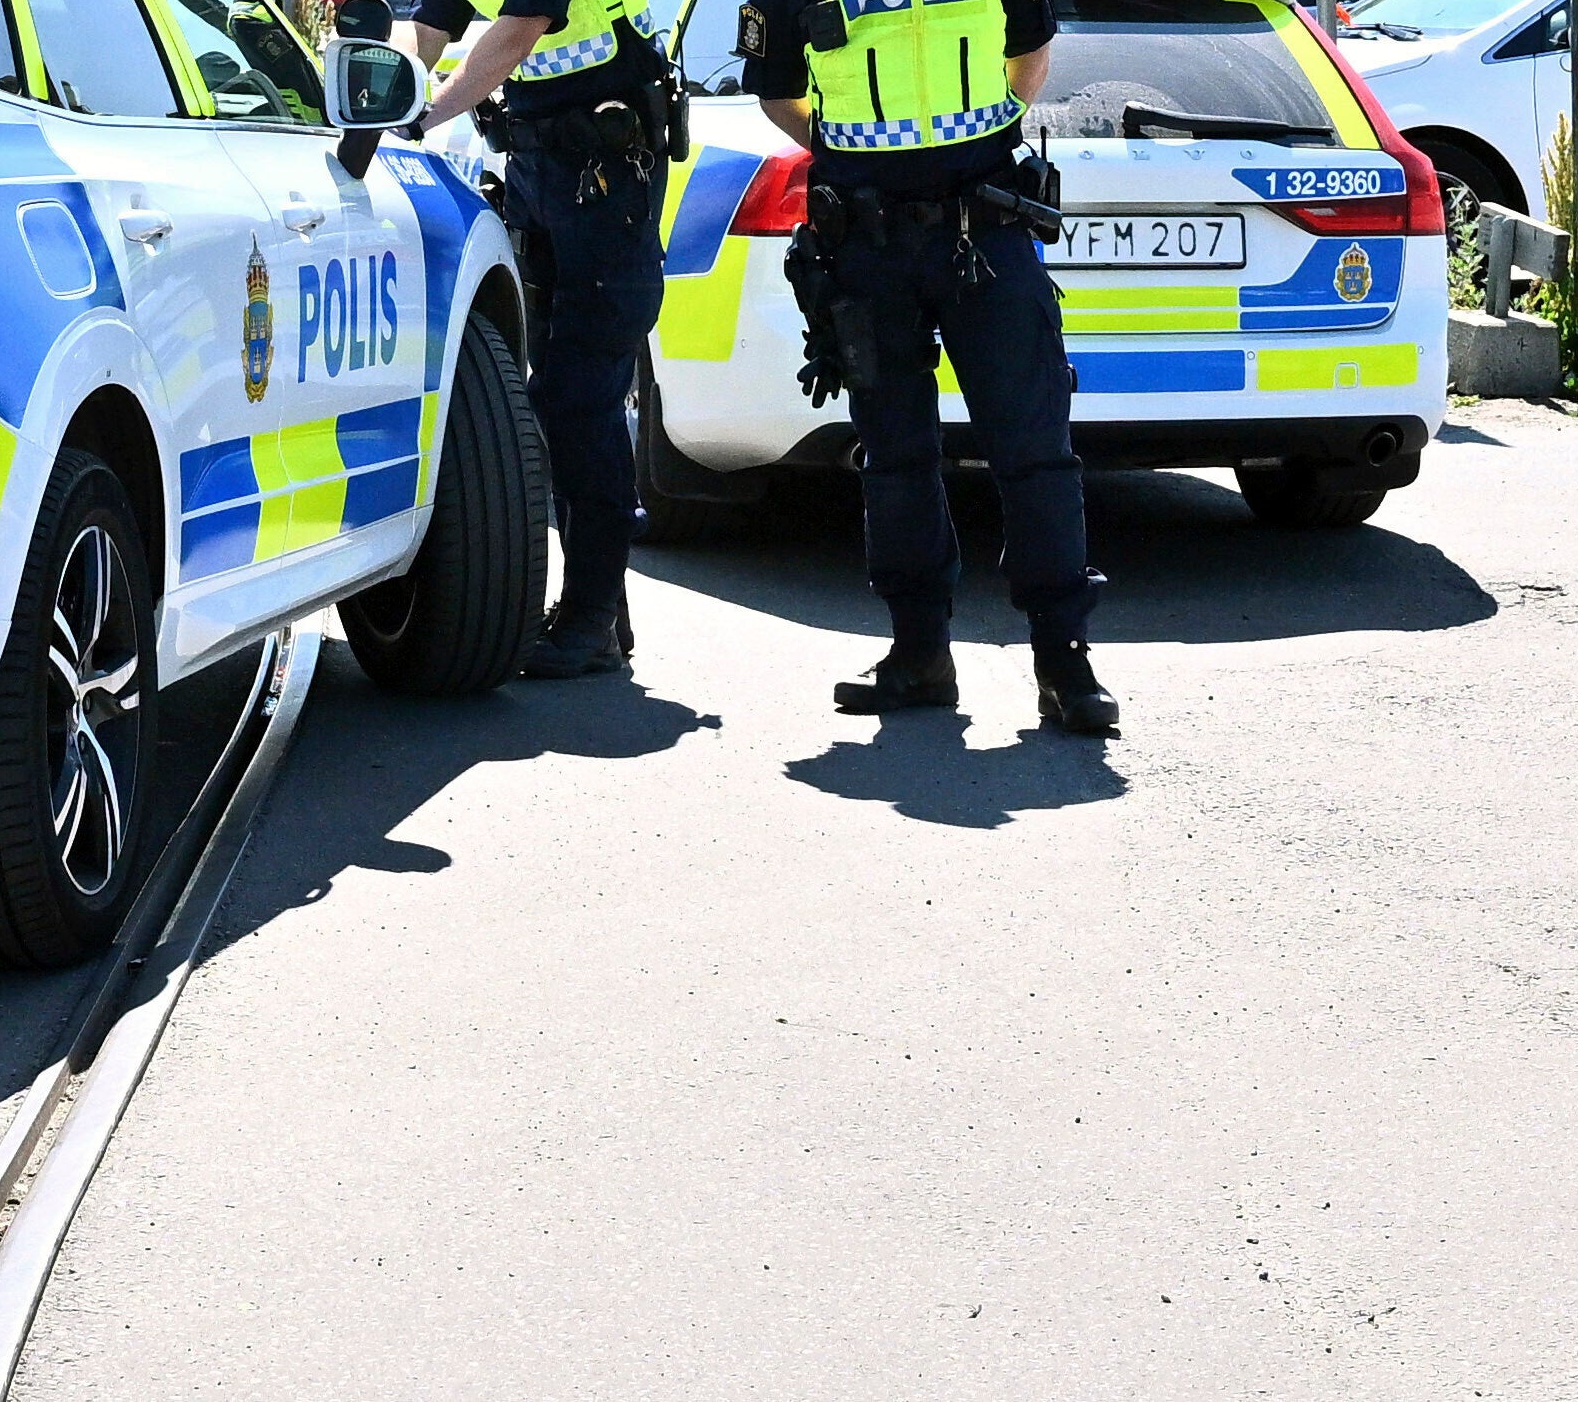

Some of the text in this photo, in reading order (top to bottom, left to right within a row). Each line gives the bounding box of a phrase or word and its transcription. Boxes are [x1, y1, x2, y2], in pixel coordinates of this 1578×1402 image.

[1265, 169, 1381, 196] 1 32-9360
[1060, 222, 1224, 257] YFM 207
[297, 250, 398, 383] POLIS
